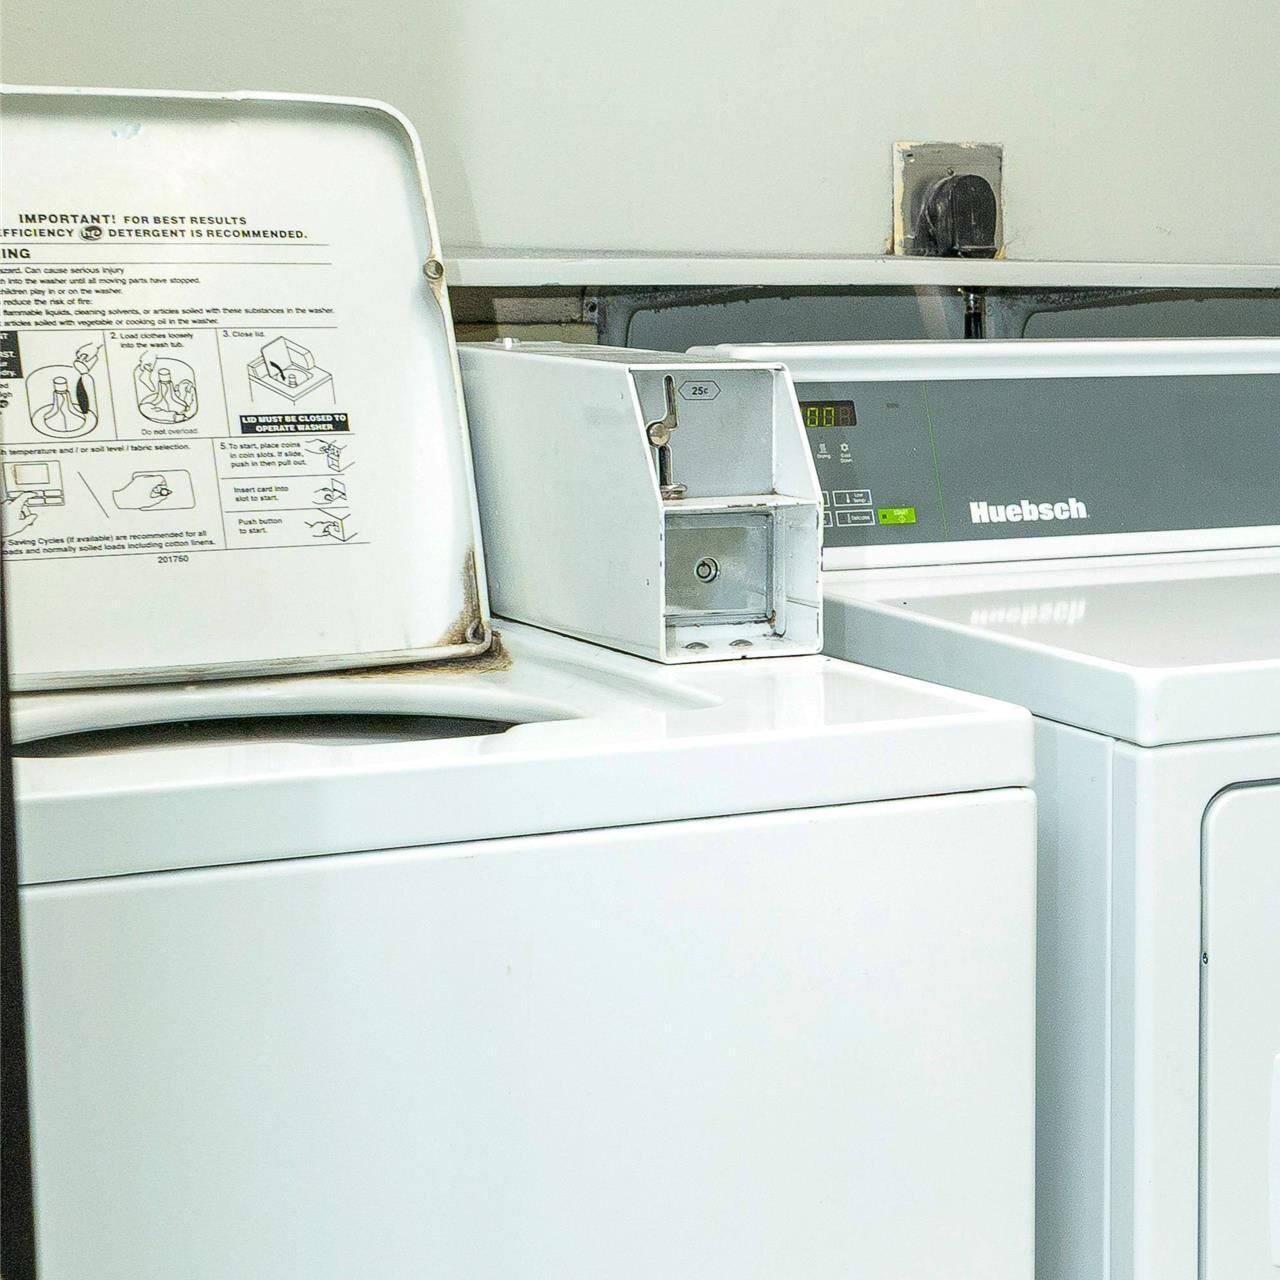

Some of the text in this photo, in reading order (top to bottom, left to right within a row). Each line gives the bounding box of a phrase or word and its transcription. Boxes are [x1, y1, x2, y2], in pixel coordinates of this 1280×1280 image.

[18, 214, 247, 225] IMPORTANT! FOR BEST RESULTS
[0, 228, 74, 237] FFICIENCY
[108, 228, 186, 238] DETERGENT
[190, 229, 203, 238] IS
[206, 229, 309, 239] RECOMMENDED.
[24, 266, 42, 274] Can
[102, 267, 124, 276] injury
[169, 277, 201, 285] stopped.
[30, 288, 45, 296] play
[77, 319, 114, 327] vegetable
[168, 332, 194, 340] loosely
[255, 423, 334, 432] OPERATE WASHER
[260, 442, 279, 450] place
[9, 448, 57, 456] temperature
[231, 461, 250, 469] push
[277, 460, 292, 468] pull
[969, 497, 1088, 524] Huebsch
[238, 517, 283, 526] Push button
[8, 538, 36, 546] Saving
[38, 537, 65, 545] Cycles
[129, 531, 184, 540] recommended
[42, 545, 77, 553] normally
[79, 544, 103, 552] soiled
[104, 542, 126, 550] loads
[127, 541, 163, 549] including
[164, 540, 189, 548] cotton
